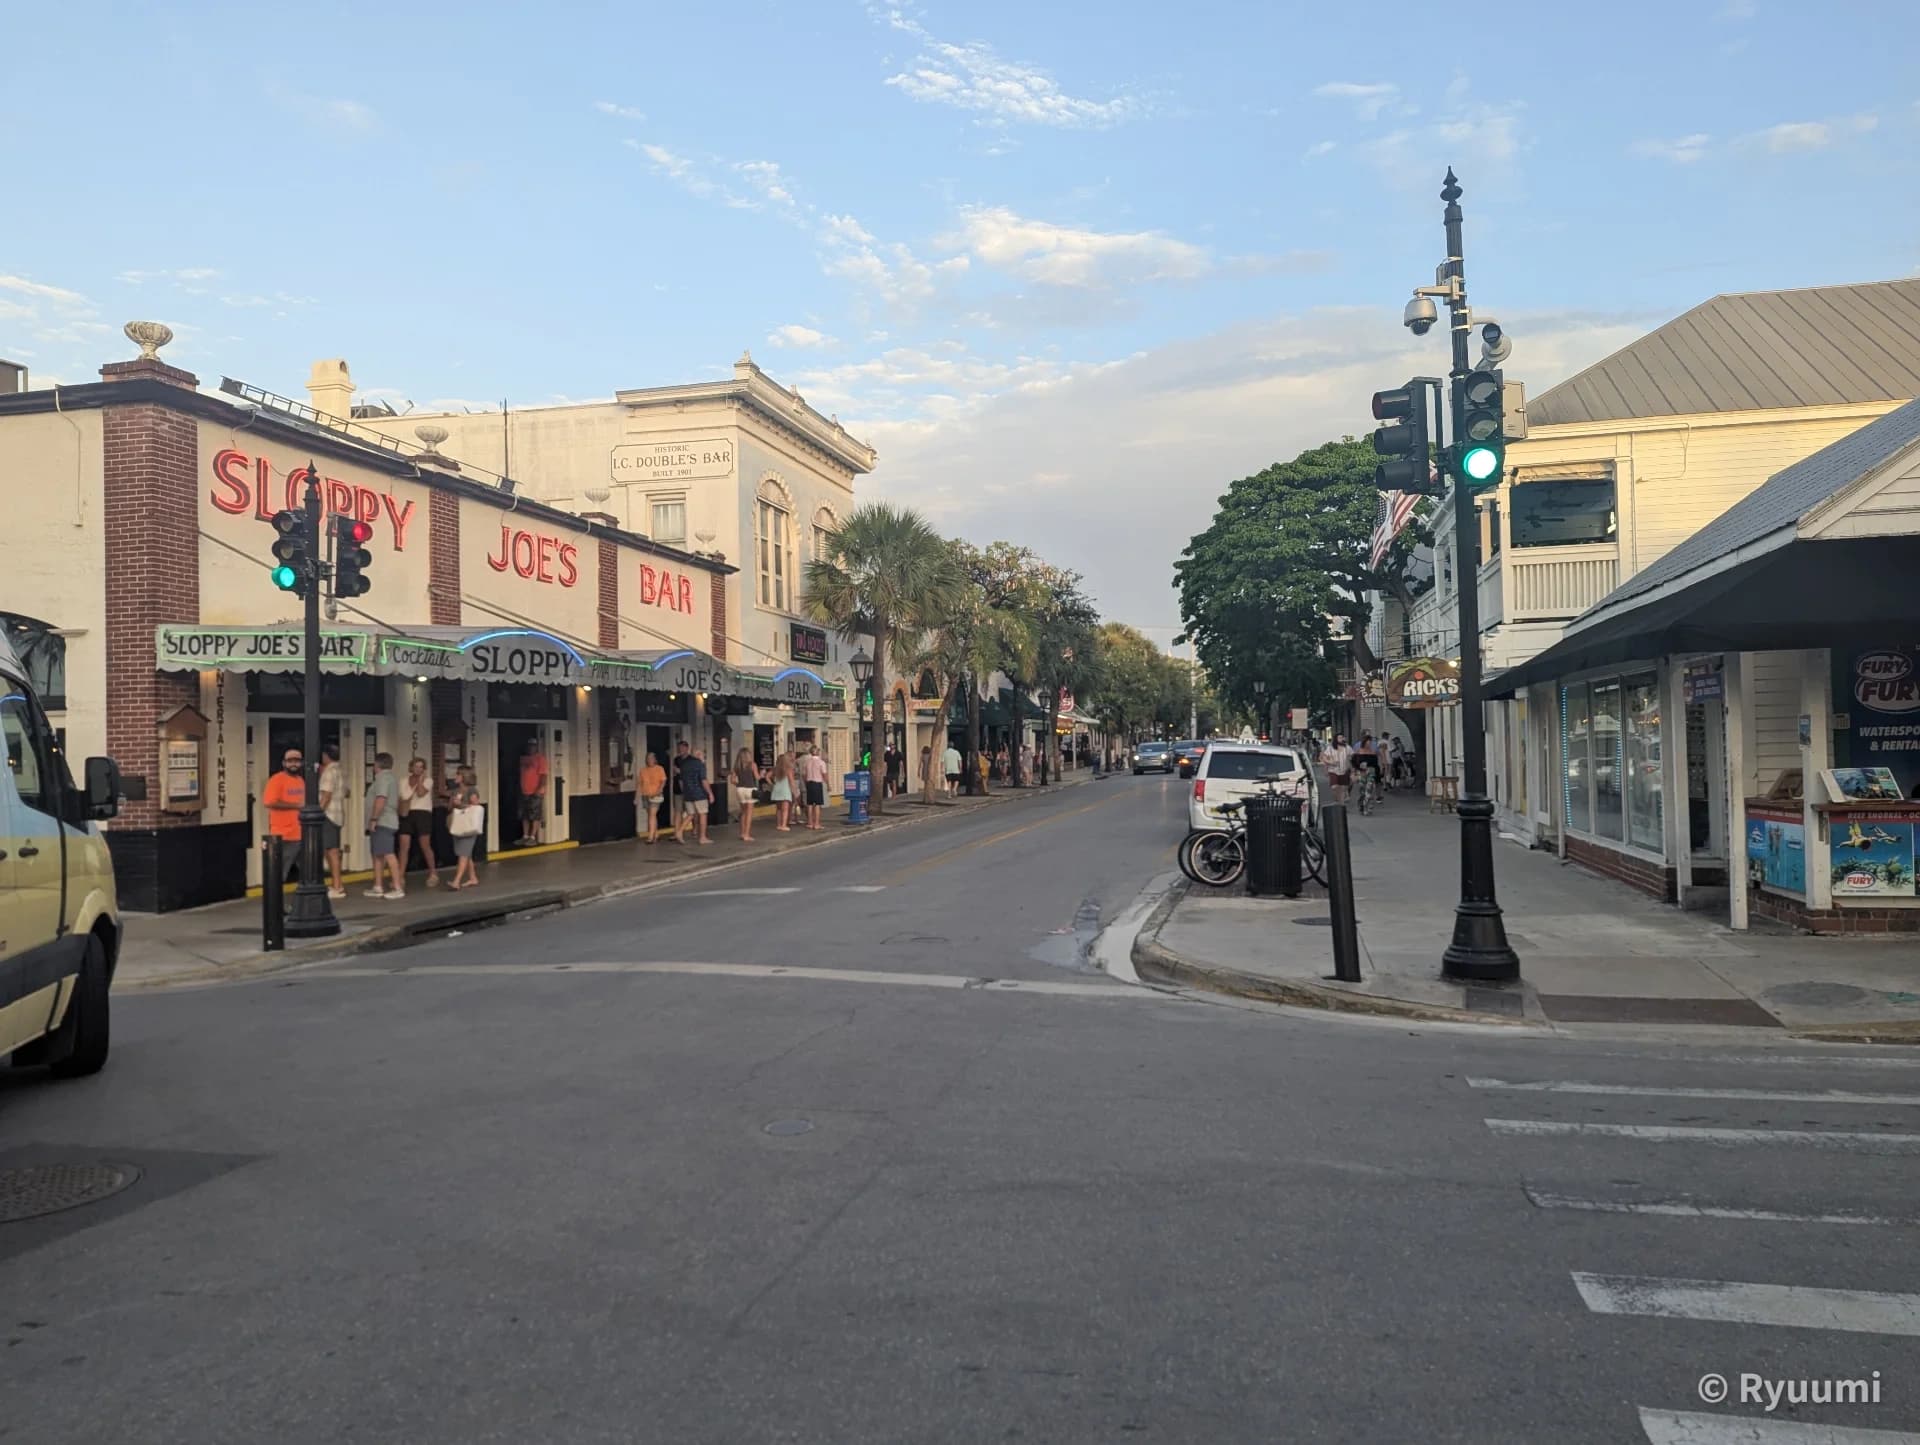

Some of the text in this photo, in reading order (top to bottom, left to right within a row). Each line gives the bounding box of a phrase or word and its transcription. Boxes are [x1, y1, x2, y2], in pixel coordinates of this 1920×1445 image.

[655, 445, 690, 453] HISTORIC
[636, 453, 697, 468] DOUBLE'S
[703, 451, 731, 464] BAR
[211, 449, 693, 614] SLOPPY JOE'S BAR
[165, 634, 238, 656] SLOPPY
[246, 634, 300, 656] JOE'S
[393, 647, 456, 668] Cocktails
[472, 645, 574, 677] SLOPPY
[1860, 660, 1905, 674] FURY
[675, 668, 721, 692] JOE'S
[1403, 678, 1459, 696] RICK'S
[787, 681, 810, 700] BAR
[1861, 680, 1920, 702] FUR
[216, 669, 226, 817] NTERTAINMENT
[1870, 741, 1880, 751] &
[1847, 876, 1874, 885] FURY
